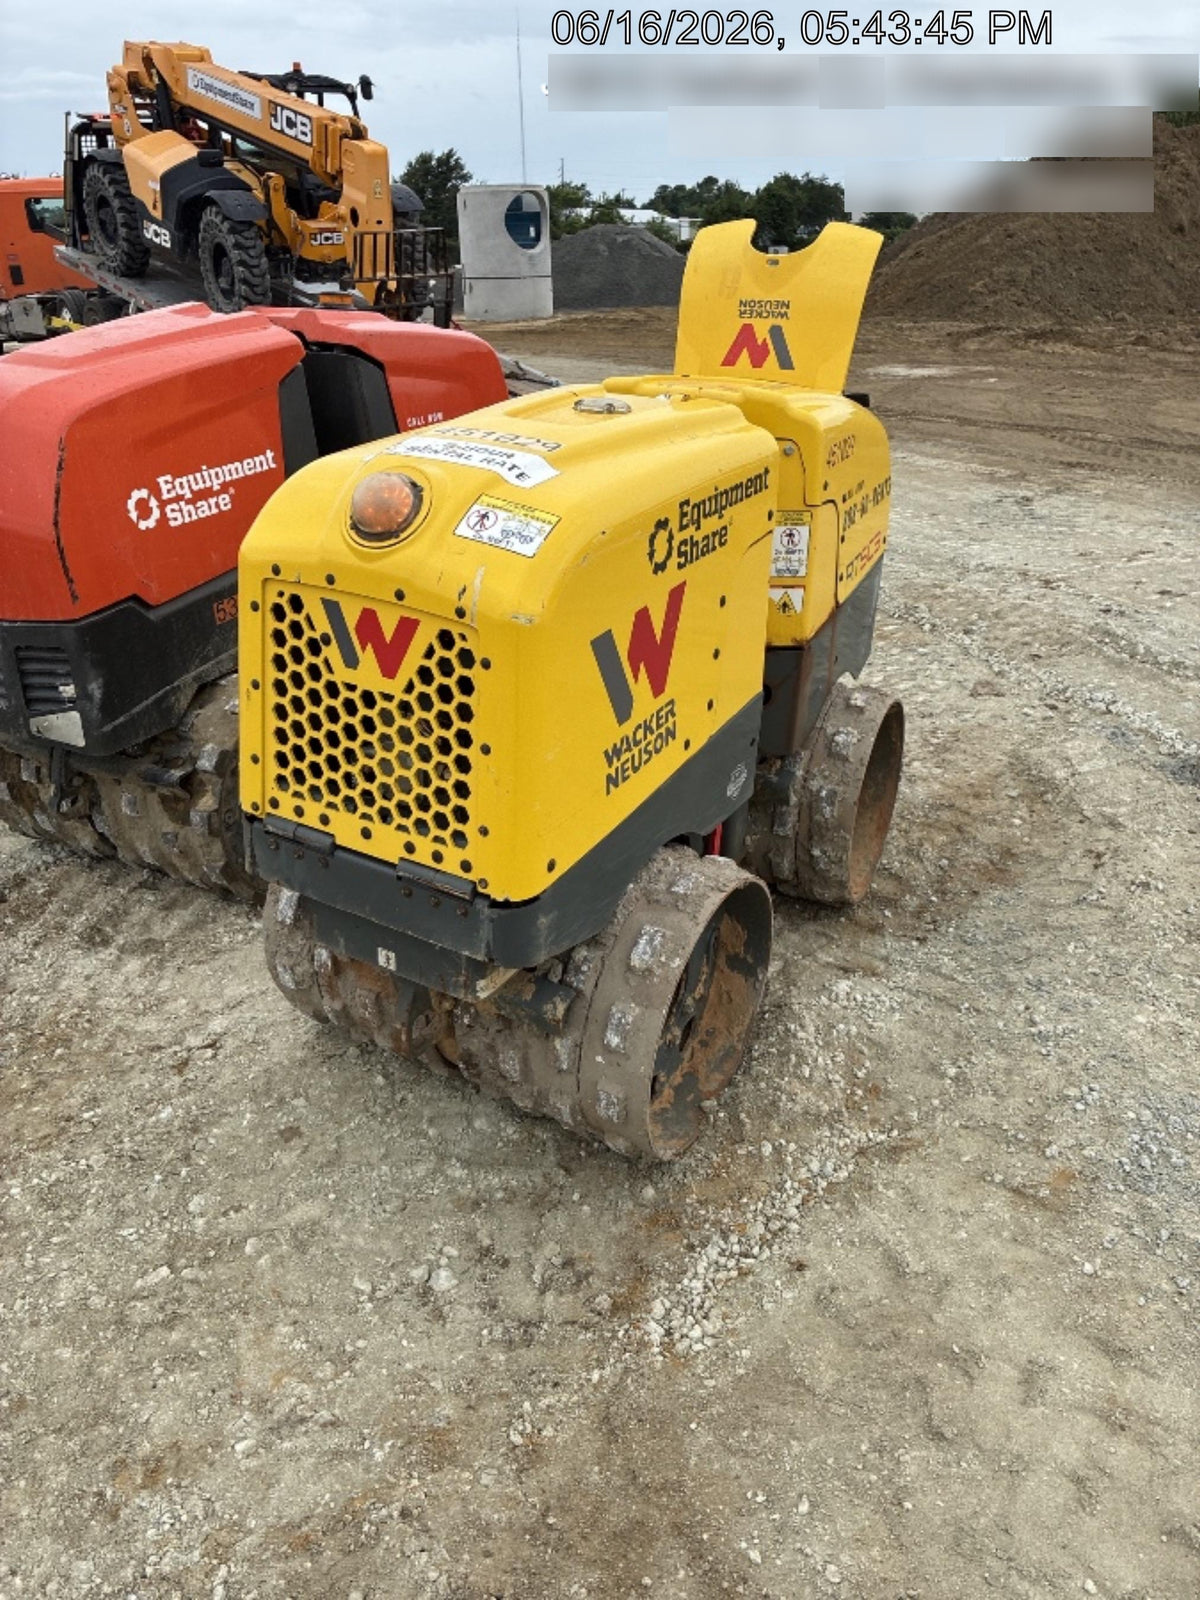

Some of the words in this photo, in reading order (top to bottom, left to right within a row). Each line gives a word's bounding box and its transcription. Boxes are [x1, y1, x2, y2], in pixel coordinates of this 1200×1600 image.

[270, 103, 312, 144] JCB
[143, 220, 172, 248] JCB
[310, 231, 345, 246] JCB
[739, 299, 790, 310] NEUSON
[739, 309, 790, 320] WACKER
[156, 449, 277, 500] Equipment
[479, 456, 531, 482] RATE
[677, 466, 770, 532] Equipment
[603, 698, 676, 769] WACKER
[605, 721, 677, 797] NEUSON
